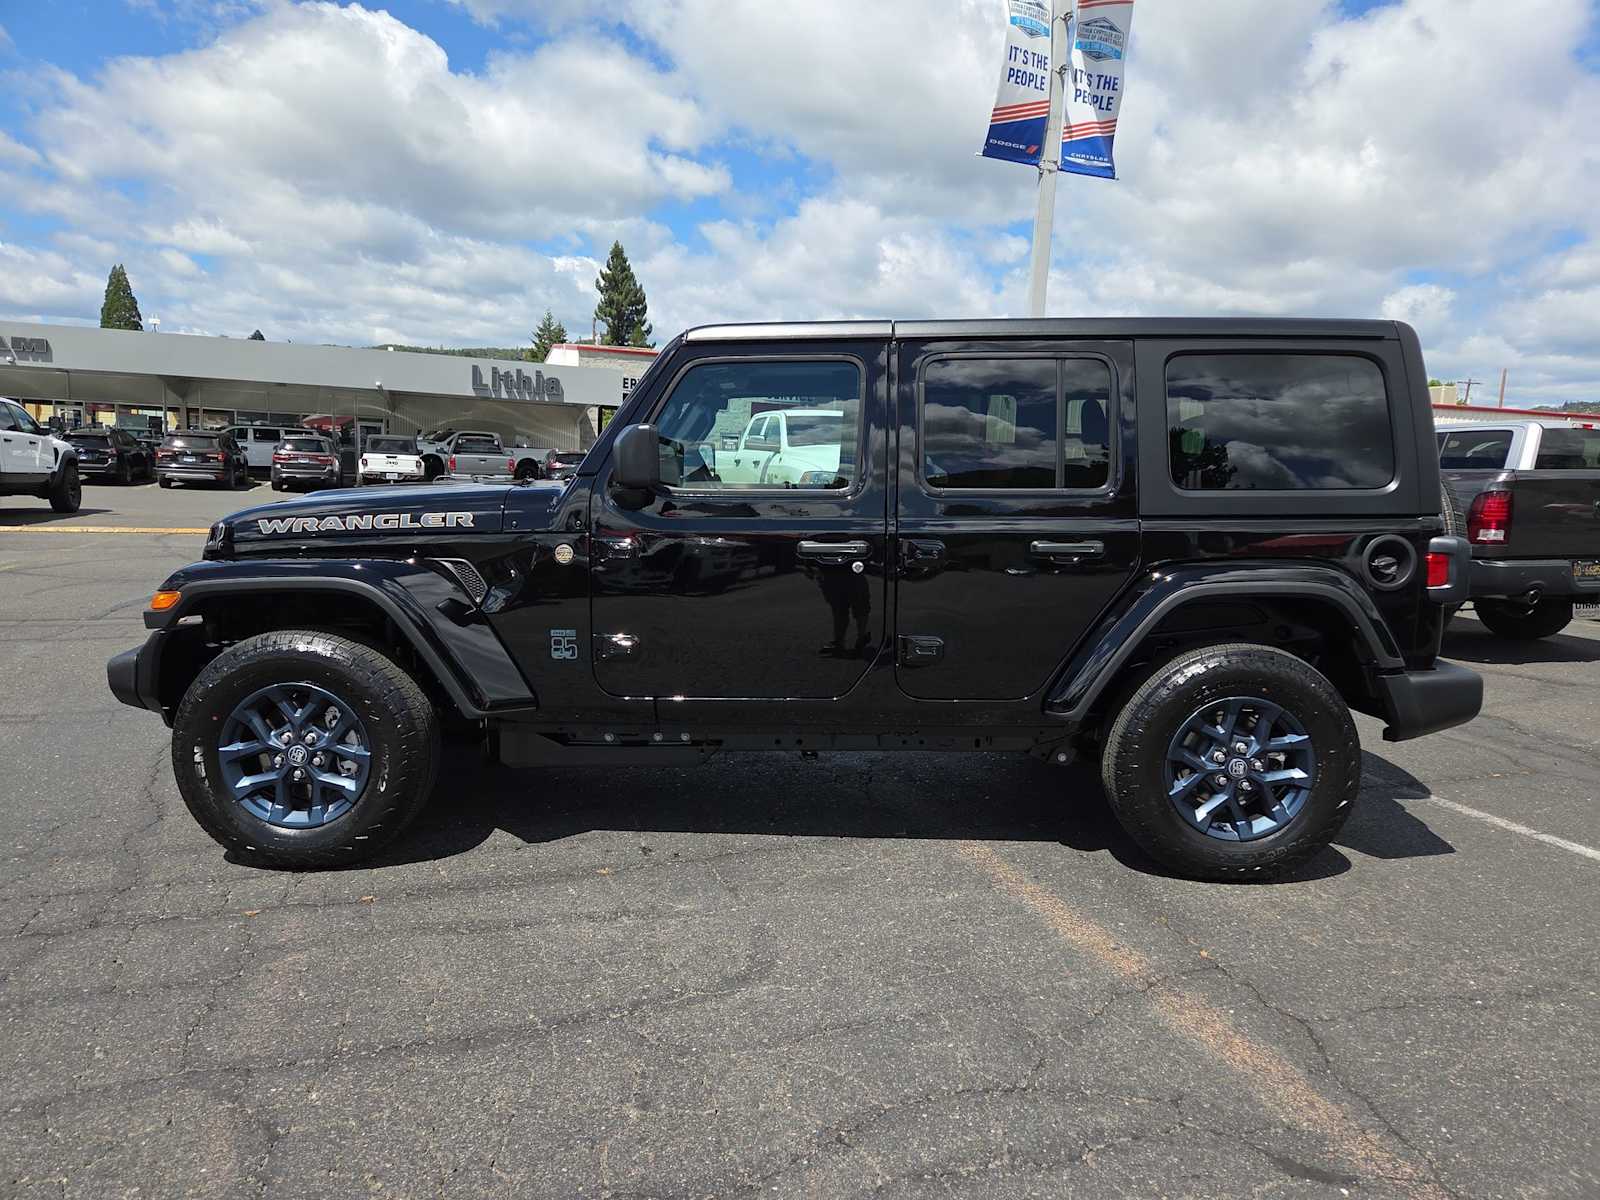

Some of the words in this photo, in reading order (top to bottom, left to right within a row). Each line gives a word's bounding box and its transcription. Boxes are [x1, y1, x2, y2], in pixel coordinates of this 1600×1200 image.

[1009, 44, 1029, 65] IT'S
[1031, 51, 1049, 72] THE
[1007, 67, 1046, 91] PEOPLE
[1074, 68, 1093, 88] IT'S
[1096, 74, 1119, 91] THE
[1073, 88, 1114, 111] PEOPLE
[989, 139, 1026, 150] DODGE
[1070, 152, 1109, 162] CHRYSLER
[472, 364, 561, 396] Lithia
[257, 511, 476, 535] WRANGLER
[551, 637, 578, 660] 85
